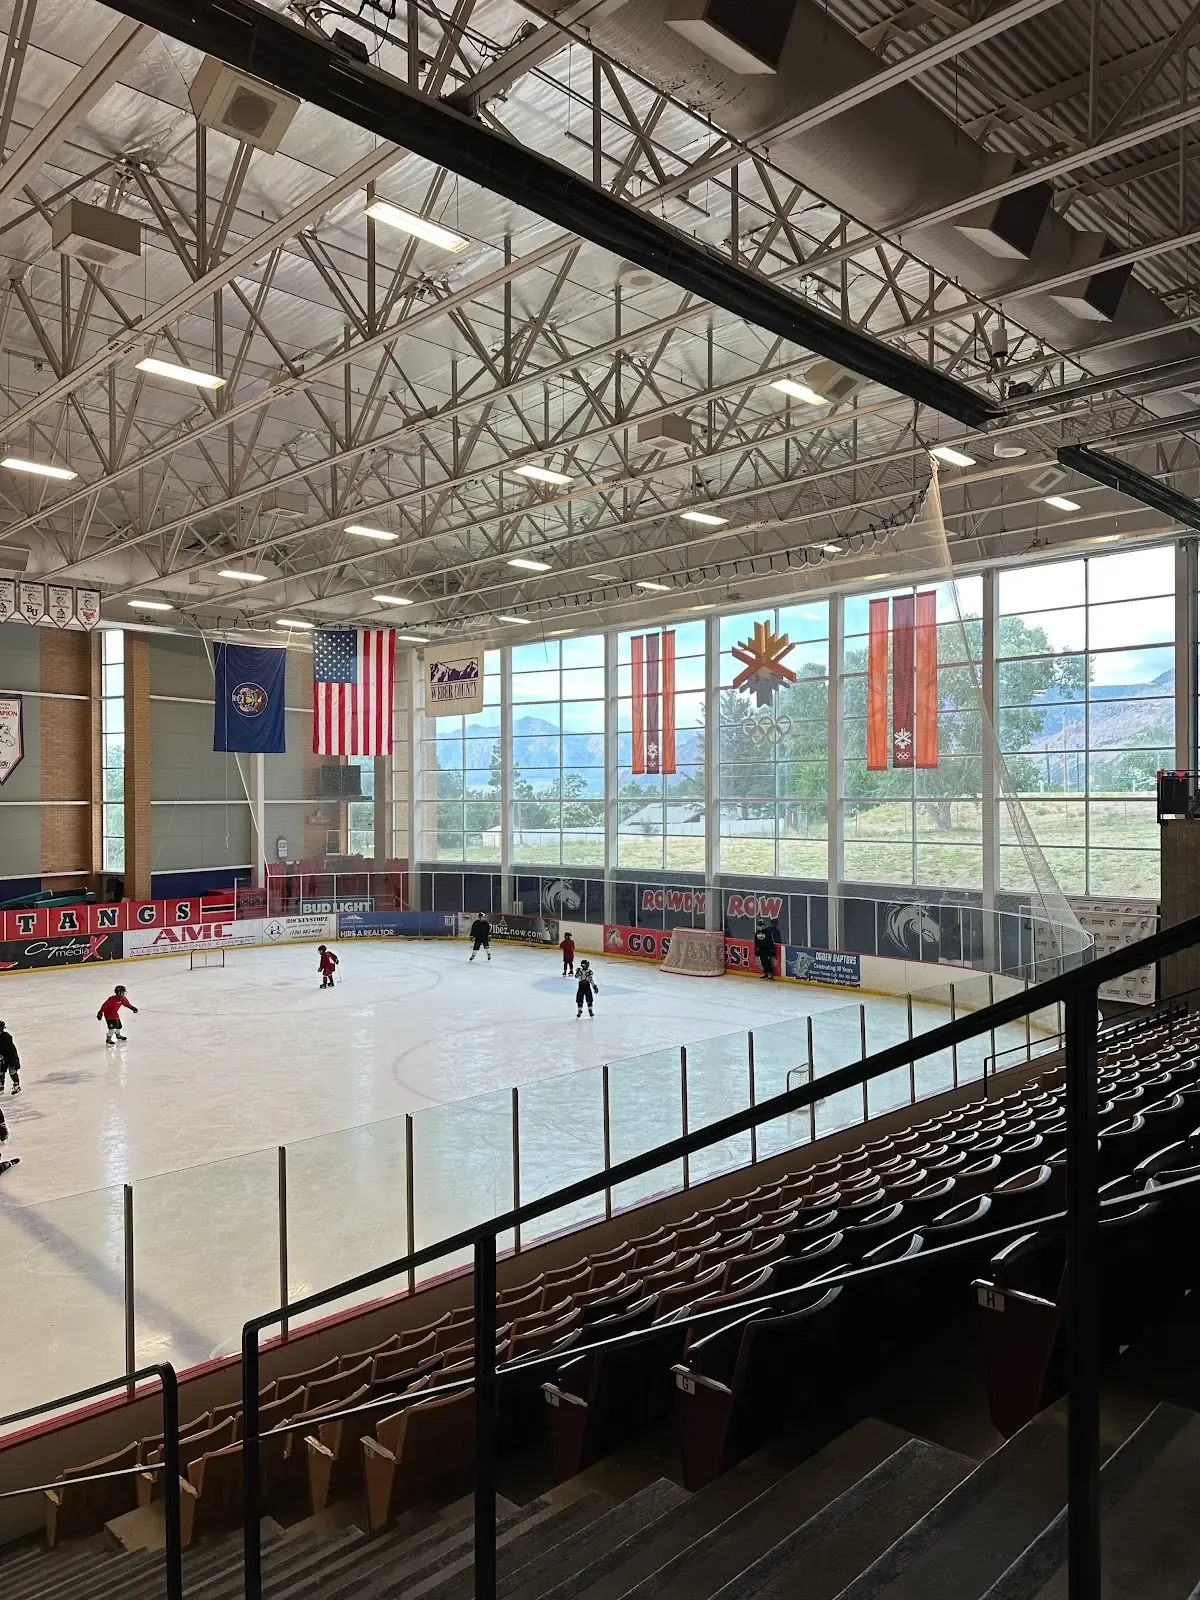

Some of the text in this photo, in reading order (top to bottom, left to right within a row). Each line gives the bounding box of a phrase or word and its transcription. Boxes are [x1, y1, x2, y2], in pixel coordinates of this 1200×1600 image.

[431, 682, 478, 700] WEBER COUNTY
[303, 901, 372, 914] BUD LIGHT
[642, 890, 783, 919] ROWDY ROW
[152, 923, 233, 945] AMC
[363, 928, 394, 937] REALTOR
[170, 942, 212, 951] MASONRY
[215, 936, 257, 946] COMPANY
[628, 934, 656, 954] GO
[815, 952, 857, 966] OGDEN RAPTORS
[813, 962, 836, 973] Celebrating
[986, 1290, 995, 1308] H
